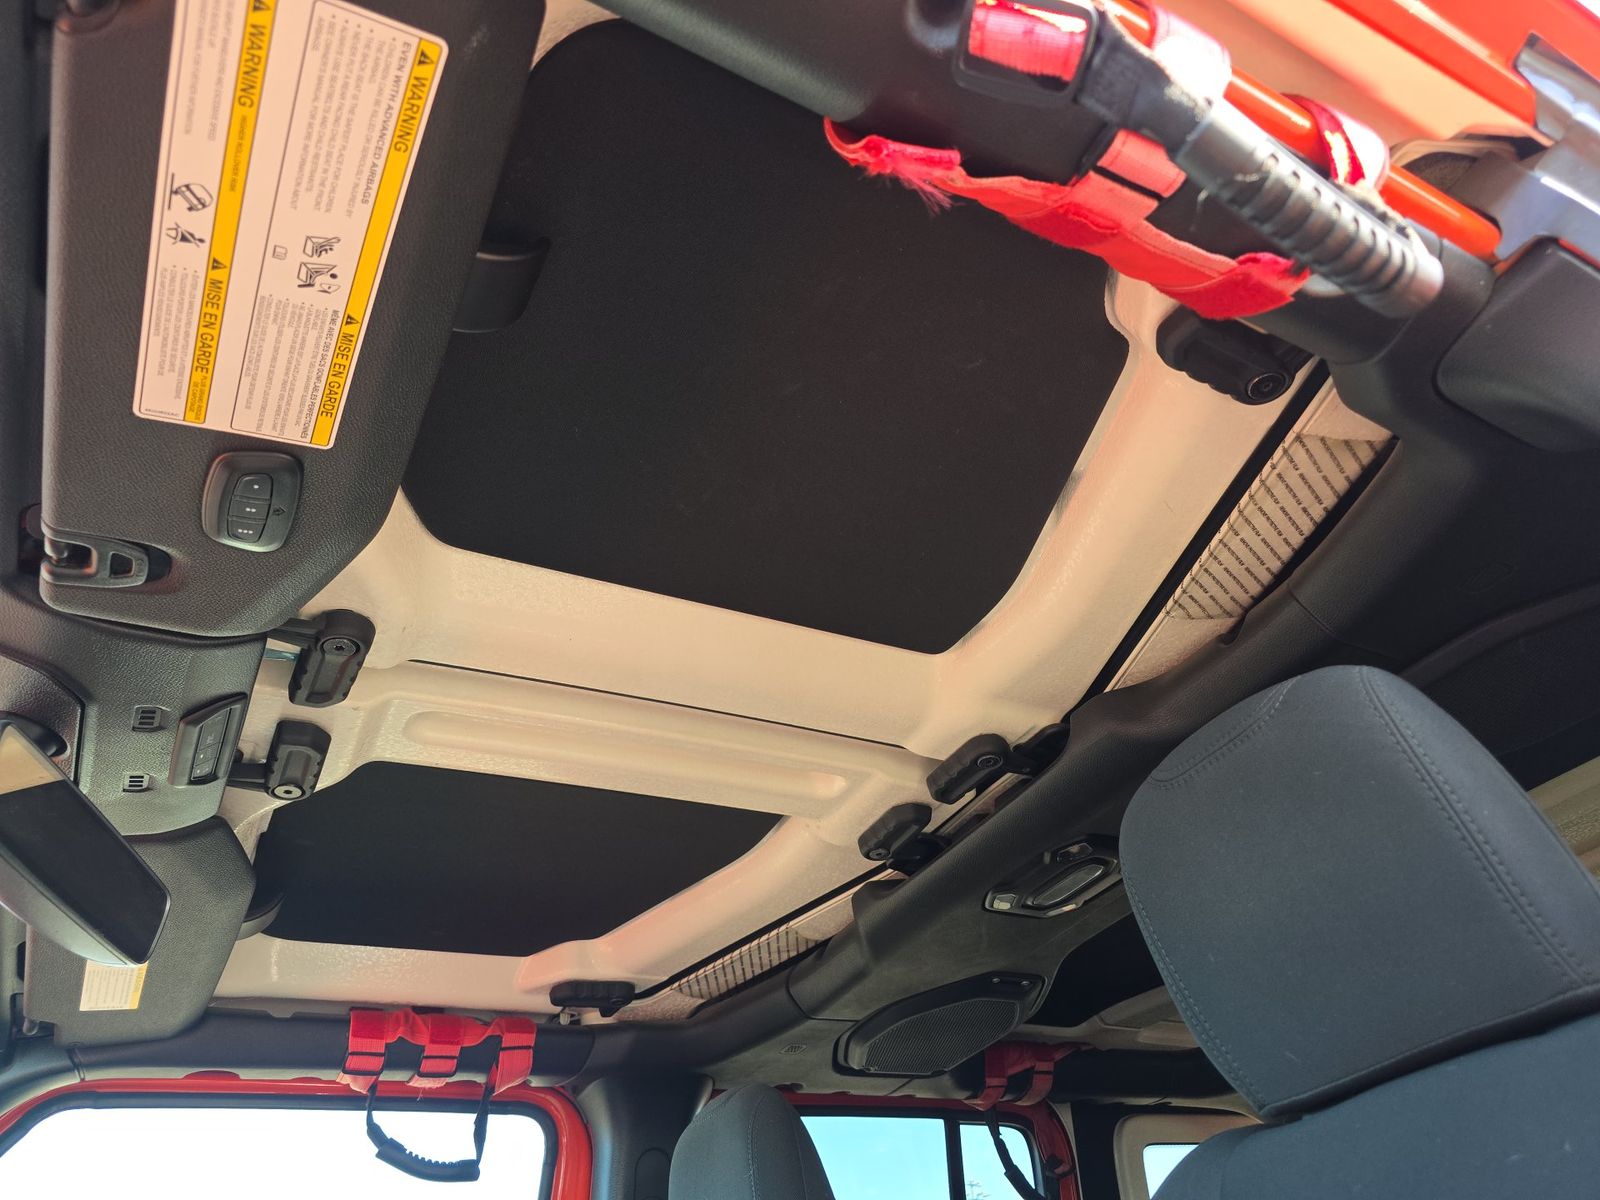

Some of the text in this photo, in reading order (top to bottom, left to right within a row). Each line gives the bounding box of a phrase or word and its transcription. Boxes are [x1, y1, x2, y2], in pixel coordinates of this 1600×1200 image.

[237, 21, 267, 109] WARNING
[360, 41, 411, 205] EVEN WITH ADVANCED AIRBAGS
[393, 74, 428, 154] WARNING
[195, 278, 223, 374] MISE EN GARDE
[300, 309, 340, 439] MÊME AVEC DES SACS GONFLABLES PERFECTIONNÉS
[320, 331, 355, 418] MISE EN GARDE
